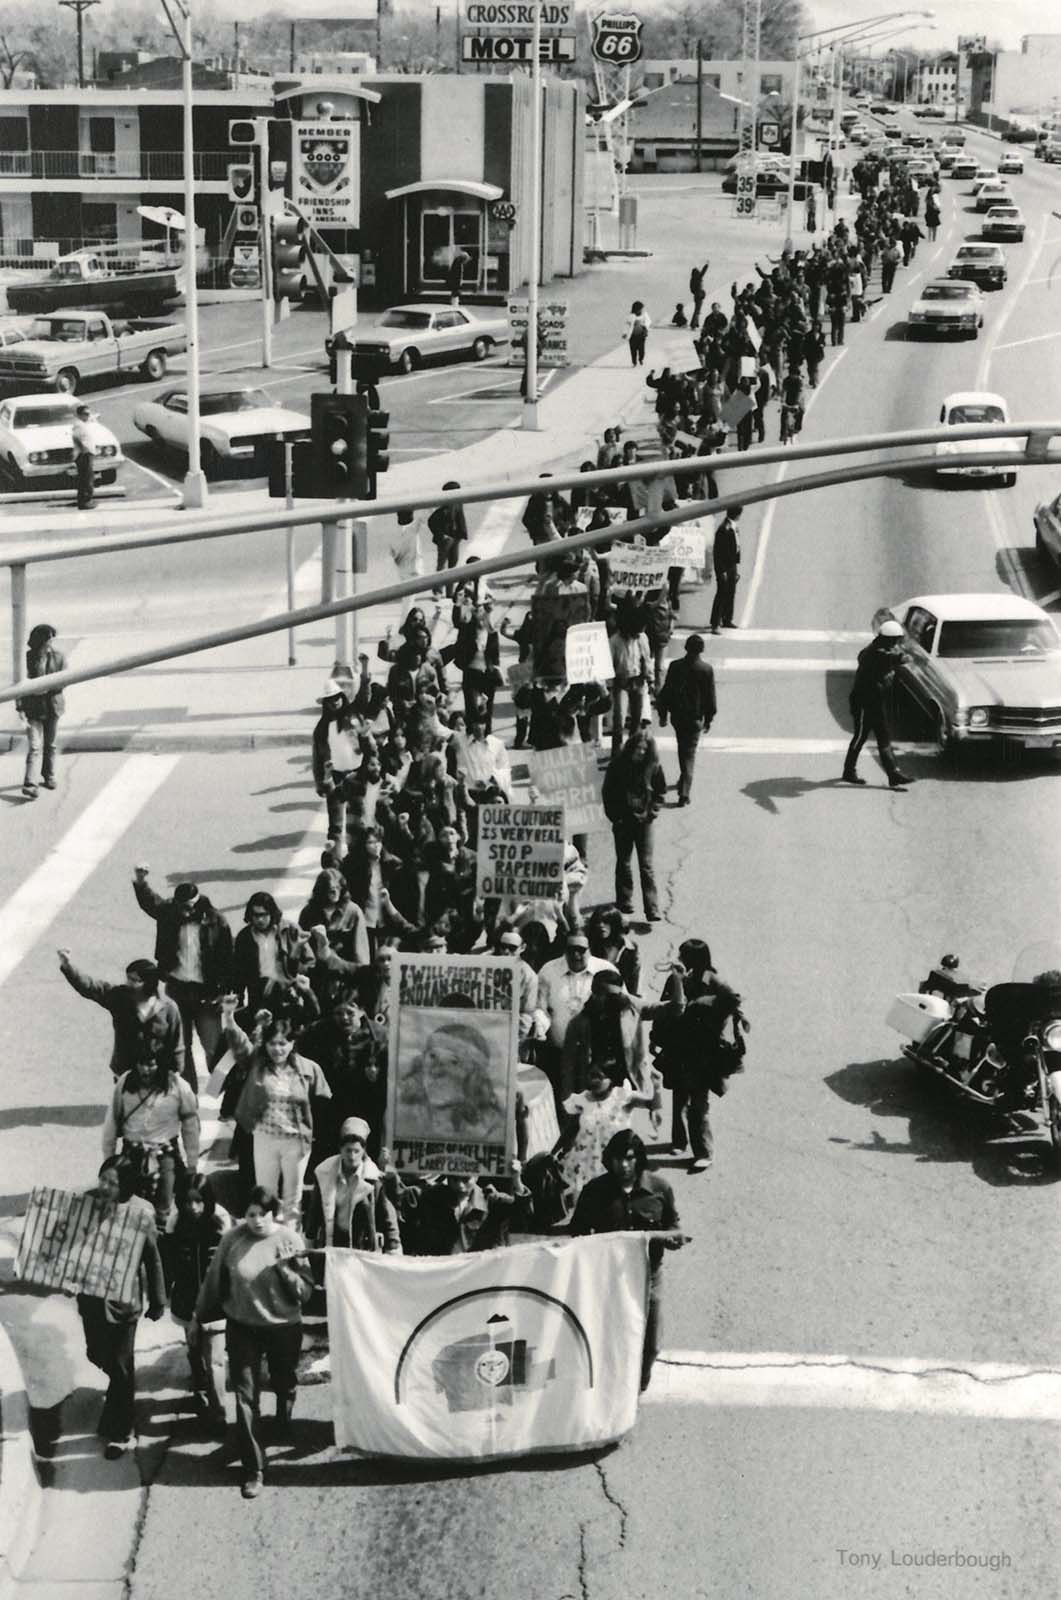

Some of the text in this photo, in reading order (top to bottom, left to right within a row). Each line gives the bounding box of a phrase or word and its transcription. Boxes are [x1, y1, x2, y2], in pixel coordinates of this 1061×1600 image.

[467, 4, 570, 24] CROSSROADS
[601, 19, 636, 31] PHILLIPS
[471, 38, 570, 59] MOTEL
[602, 35, 633, 55] 66
[298, 128, 351, 136] MEMBER
[739, 177, 754, 193] 35
[298, 197, 351, 206] FRIENDSHIP
[737, 198, 754, 213] 39
[312, 207, 335, 215] INNS
[482, 808, 563, 827] OUR CULTURE
[481, 827, 564, 843] IS VERY REAL
[488, 844, 533, 860] STOP
[495, 861, 560, 878] RAPEING
[482, 877, 516, 895] OUR
[486, 967, 513, 988] FOR
